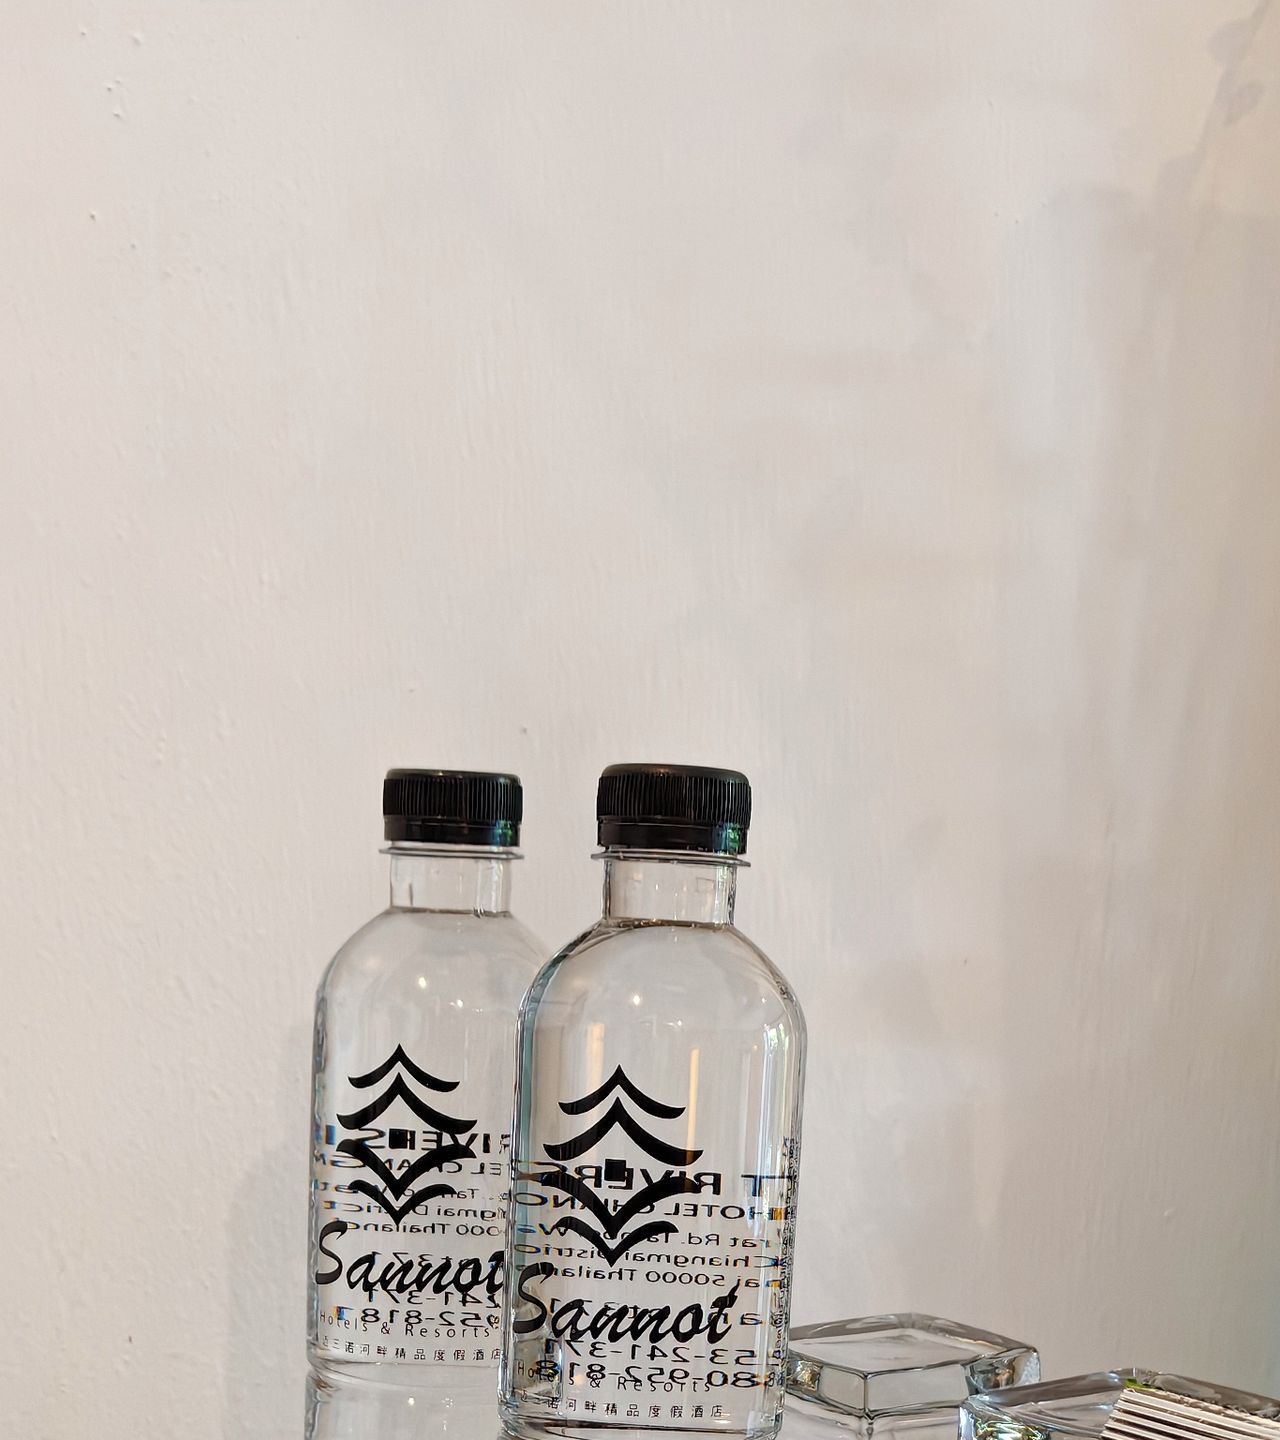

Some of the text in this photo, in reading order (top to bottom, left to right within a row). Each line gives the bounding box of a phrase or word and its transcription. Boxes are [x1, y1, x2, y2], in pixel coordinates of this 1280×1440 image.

[513, 1261, 739, 1346] Sannot
[405, 1325, 491, 1339] Resorts
[617, 1375, 711, 1394] Resorts
